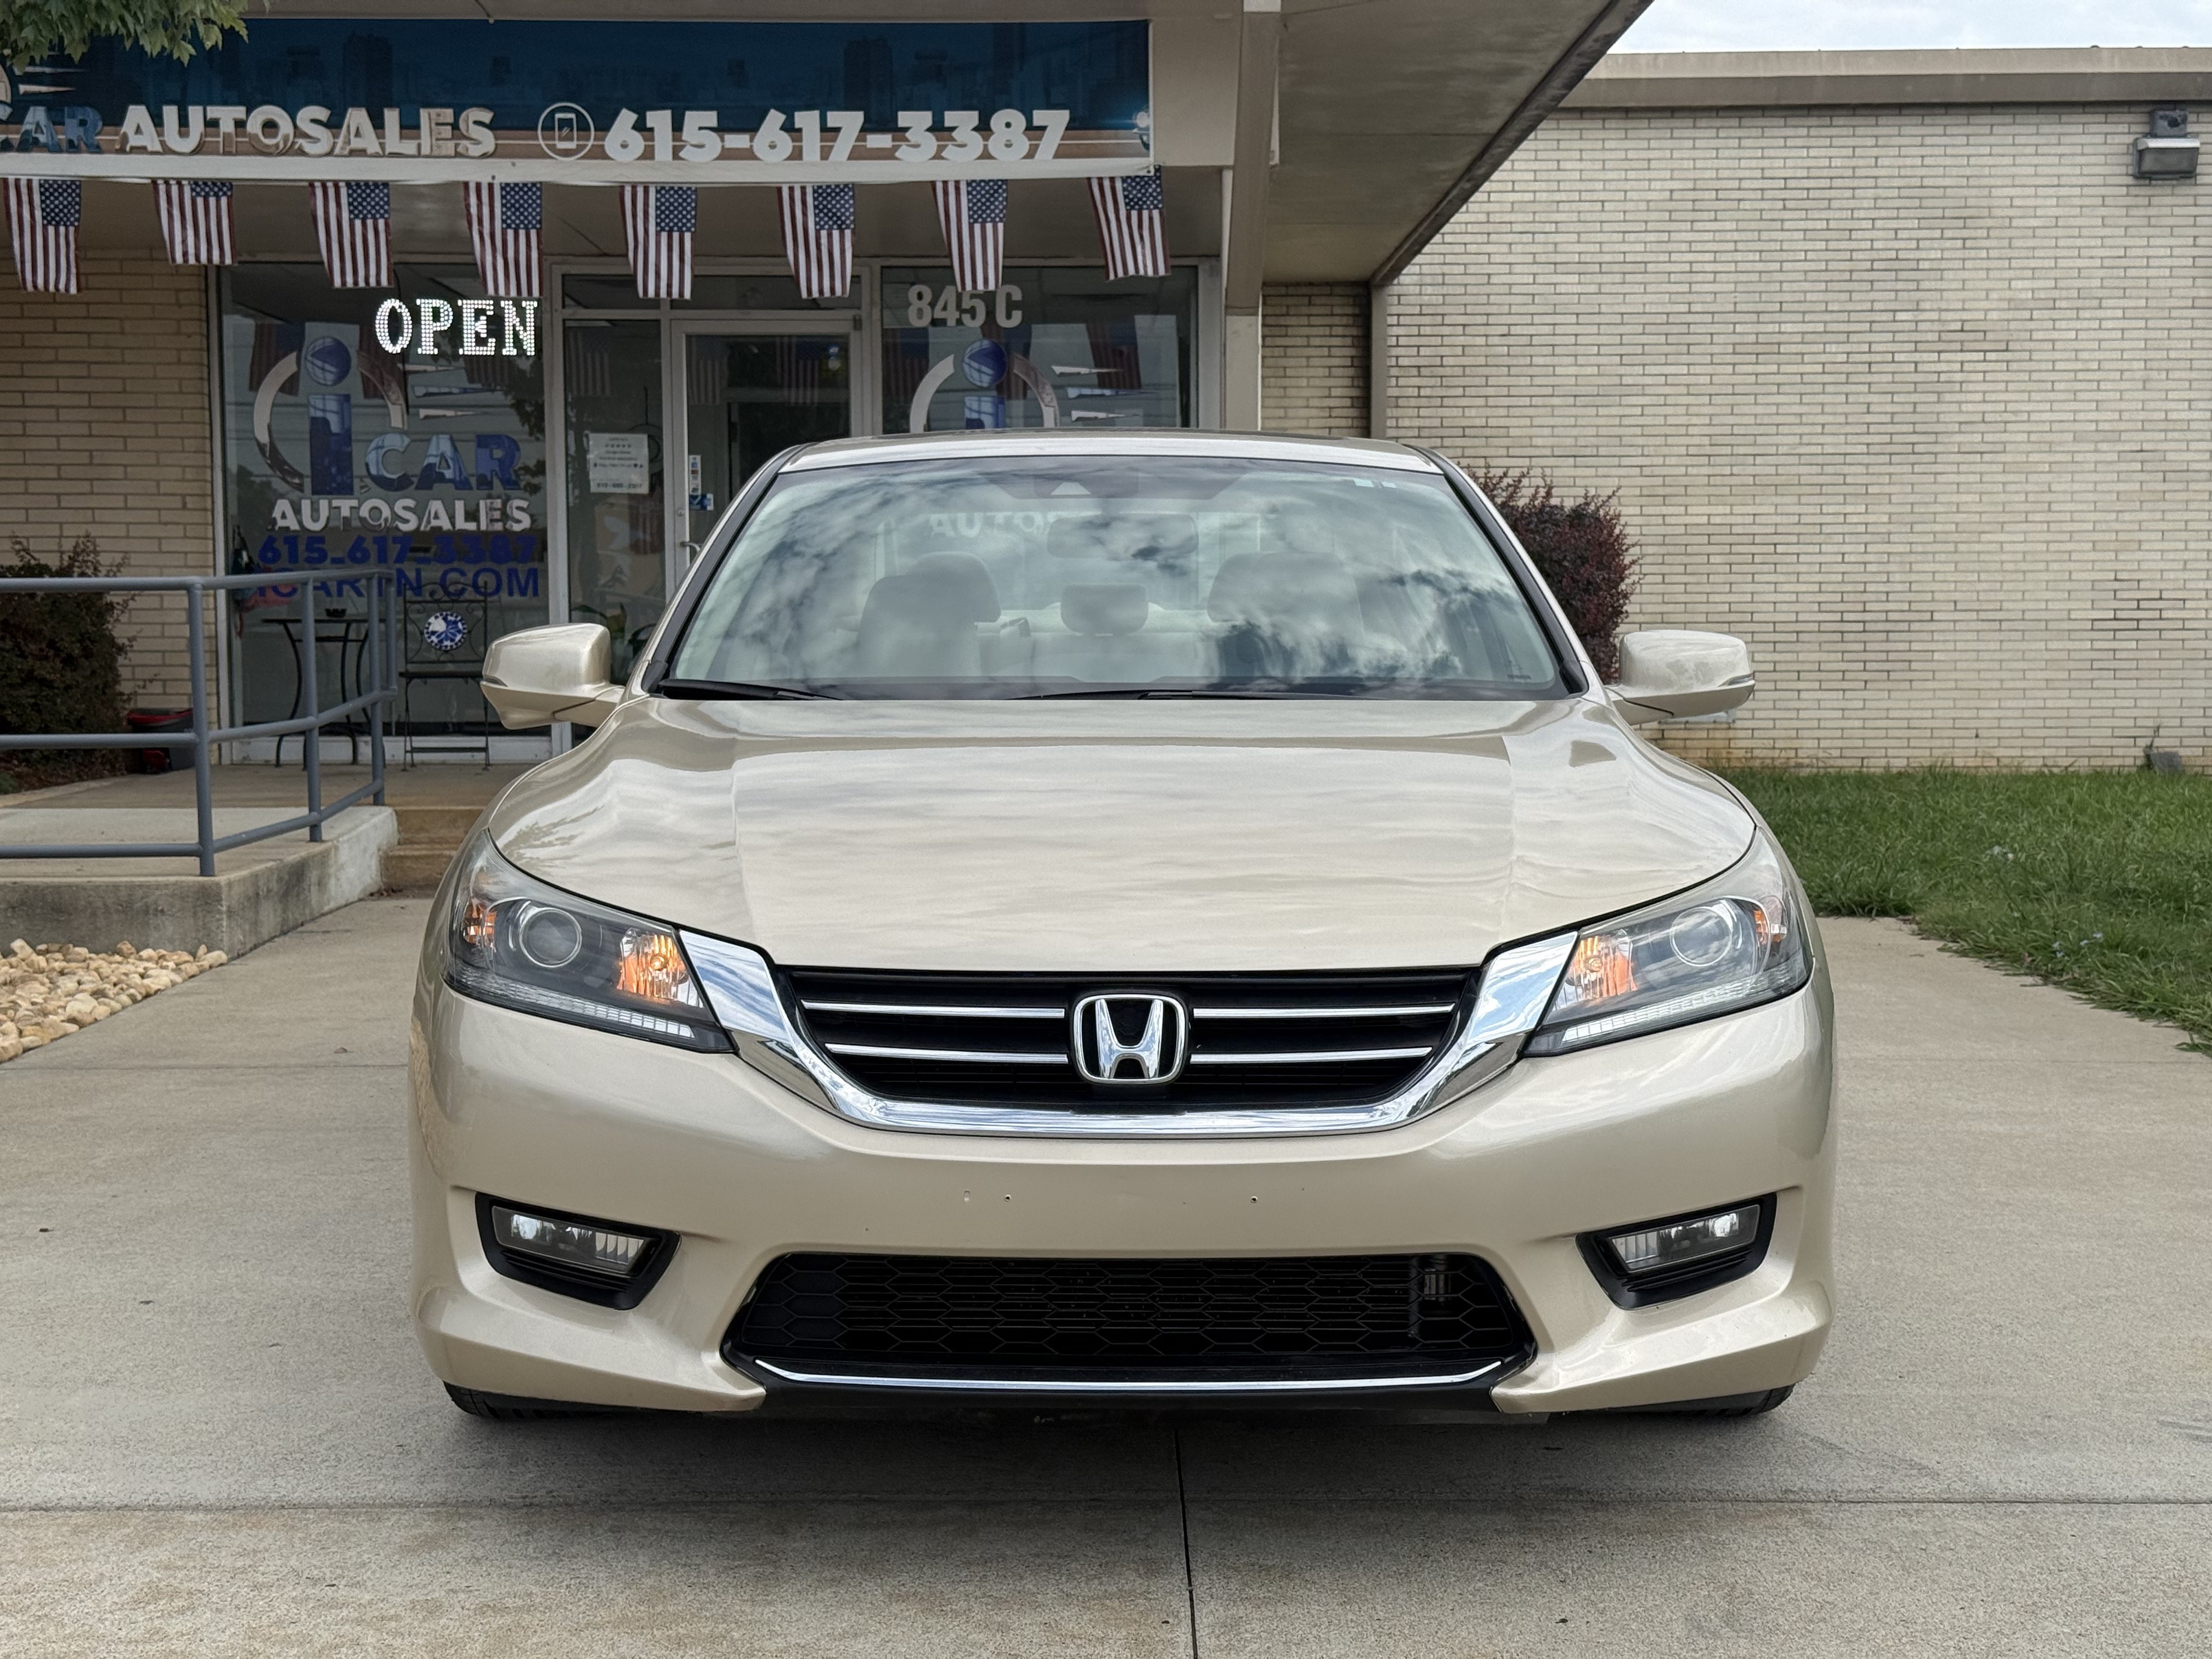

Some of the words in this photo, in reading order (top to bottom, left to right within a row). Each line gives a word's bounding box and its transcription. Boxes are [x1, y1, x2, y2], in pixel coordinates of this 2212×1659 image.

[0, 104, 103, 154] AR
[115, 105, 498, 157] AUTOSALES
[604, 108, 1070, 163] 615-617-3387
[375, 298, 539, 356] OPEN
[908, 285, 986, 328] 845
[996, 285, 1022, 328] C
[269, 498, 532, 533] AUTOSALES
